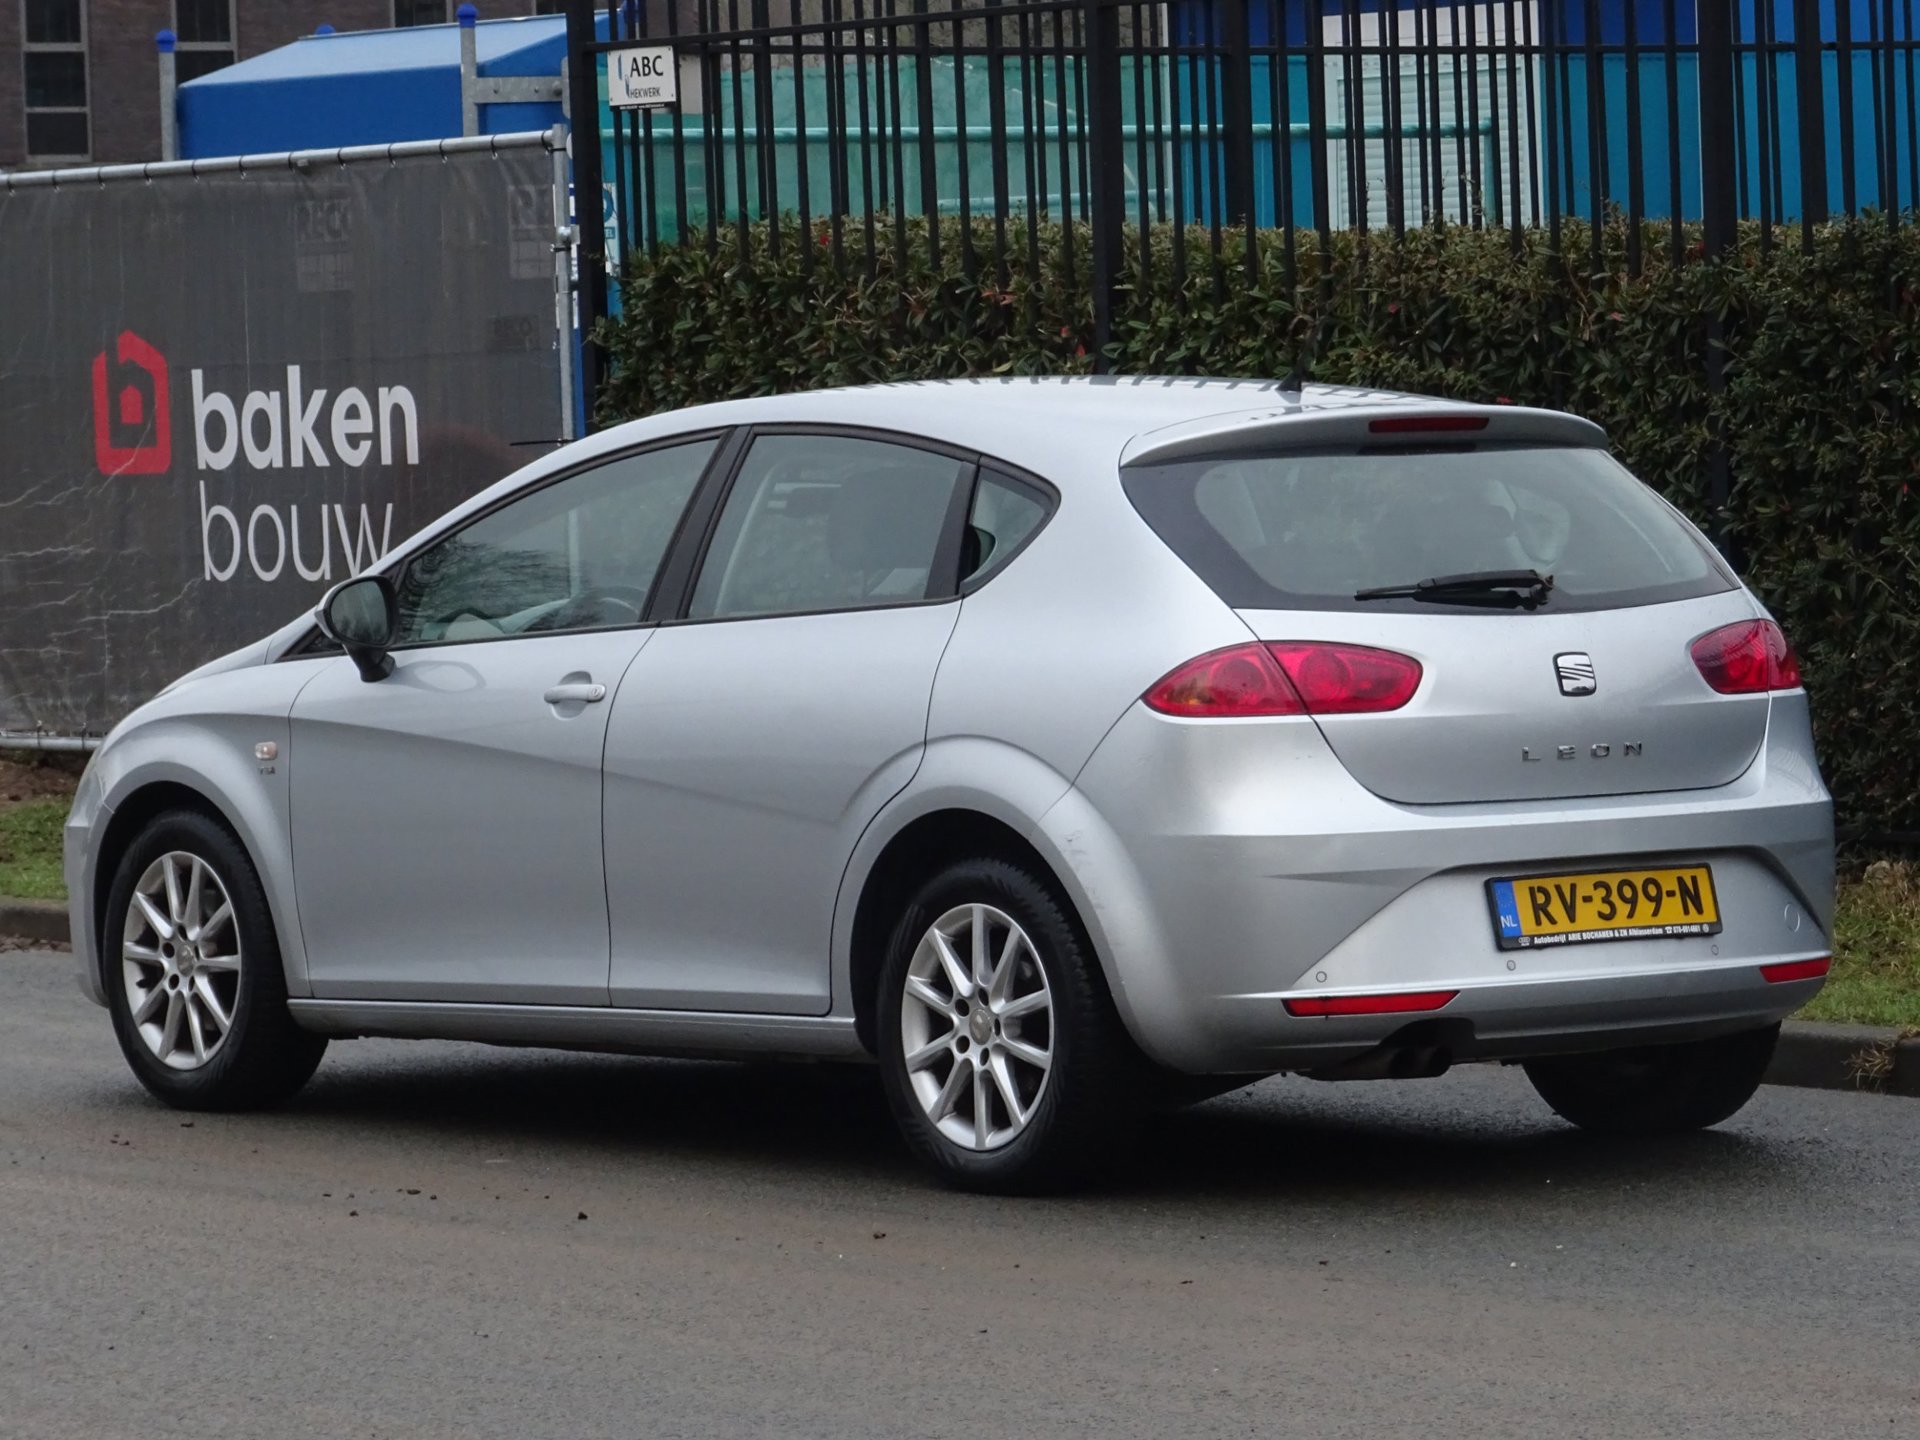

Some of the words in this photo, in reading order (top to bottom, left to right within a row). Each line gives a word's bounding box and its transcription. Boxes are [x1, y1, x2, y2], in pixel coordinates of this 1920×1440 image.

[629, 55, 664, 77] ABC
[629, 87, 661, 98] HEKWERK
[191, 364, 419, 471] baken
[200, 480, 393, 582] bouw
[1521, 741, 1643, 762] LEON
[1528, 874, 1705, 927] RV-399-N
[1501, 914, 1518, 929] NL
